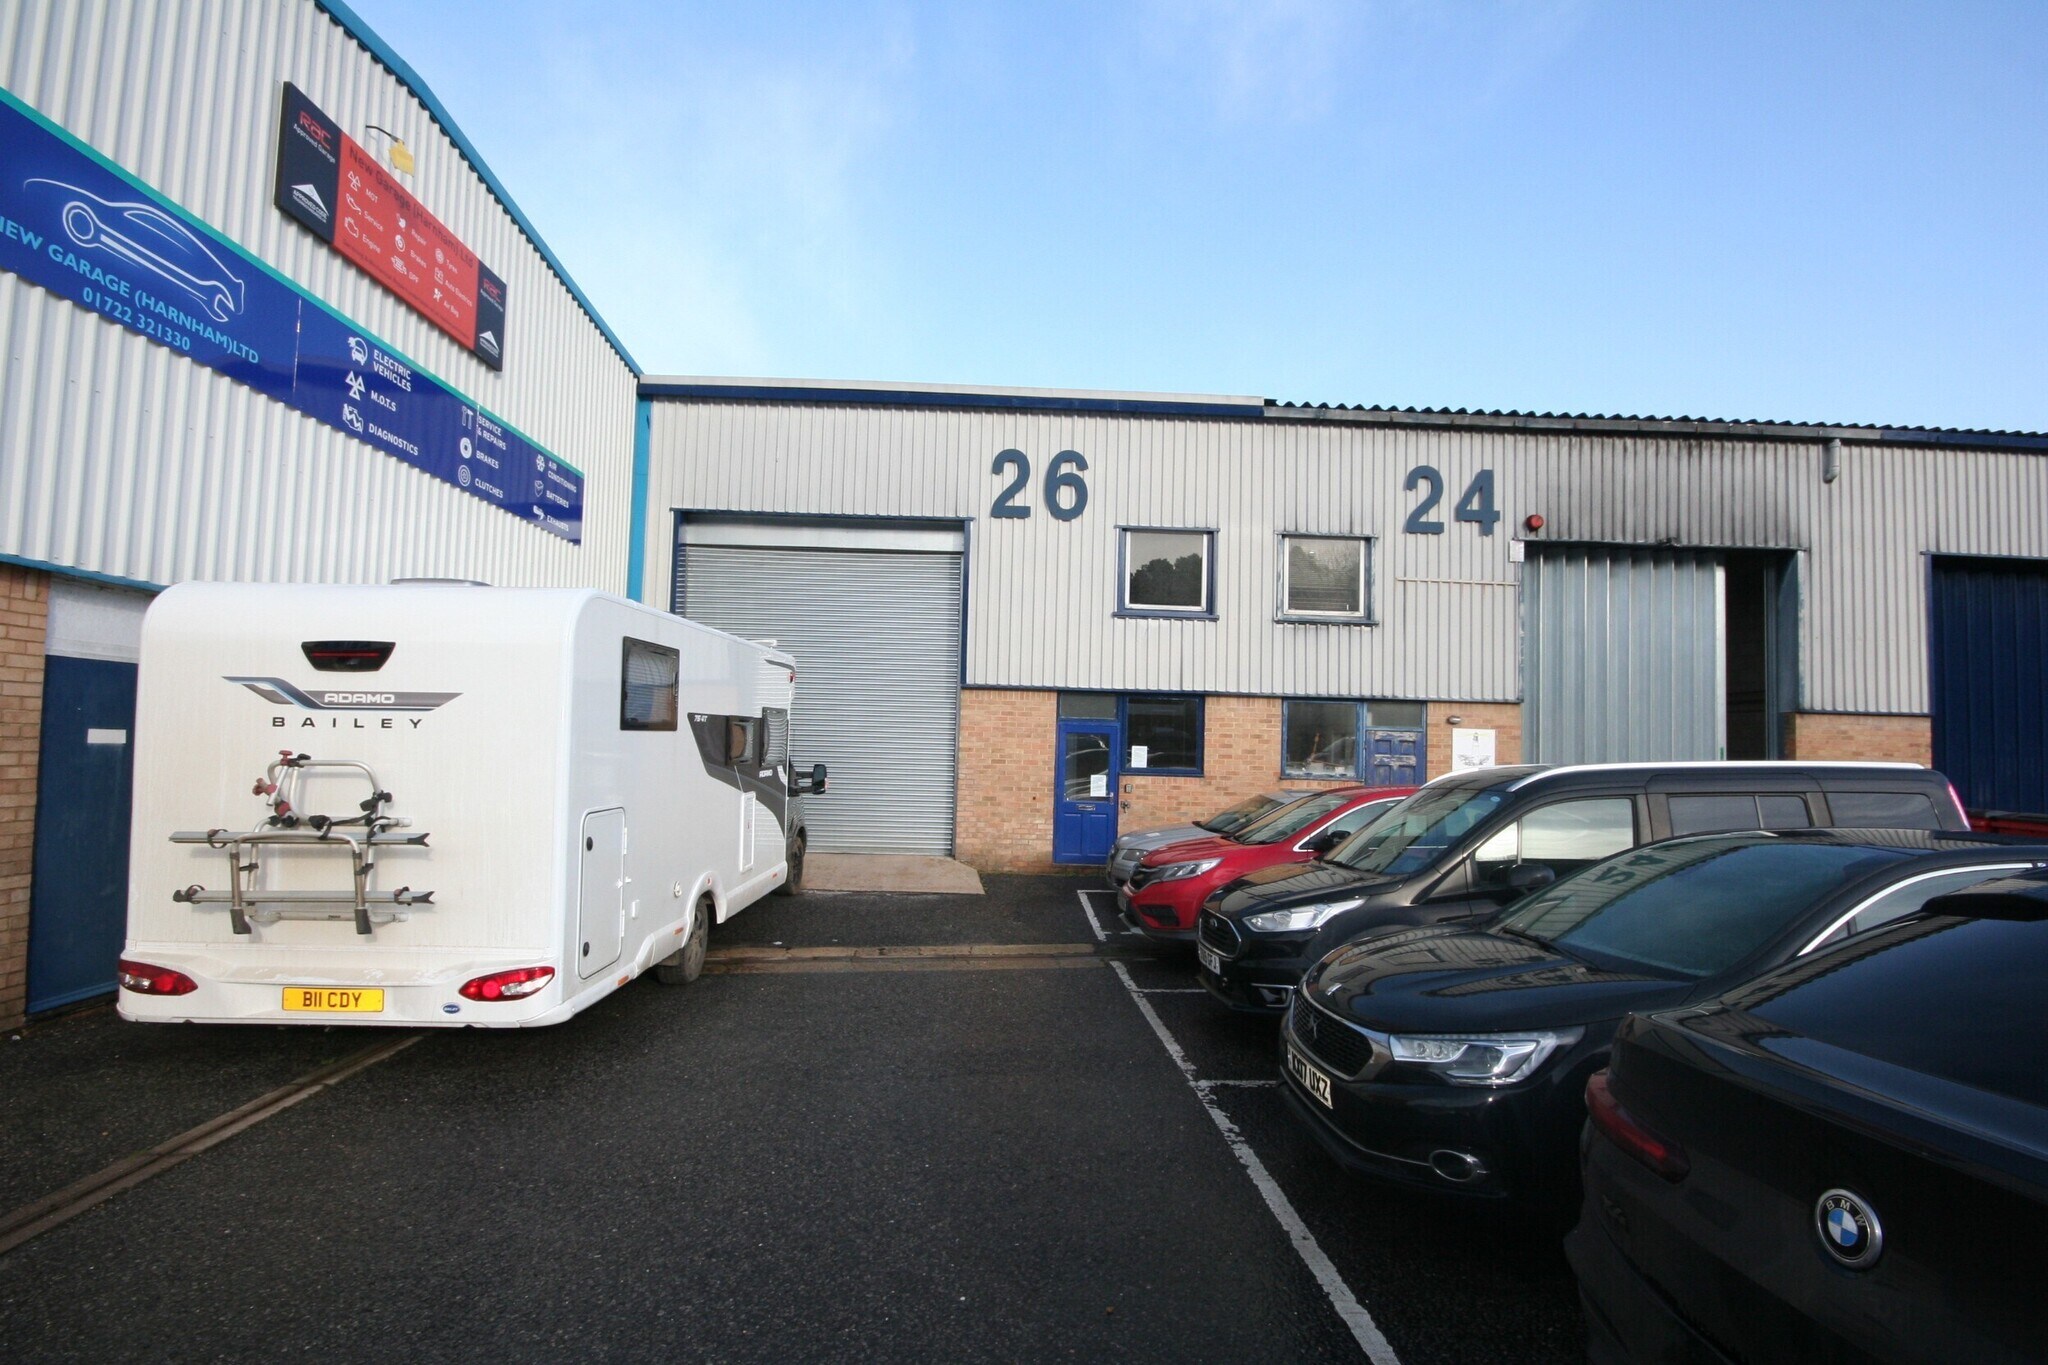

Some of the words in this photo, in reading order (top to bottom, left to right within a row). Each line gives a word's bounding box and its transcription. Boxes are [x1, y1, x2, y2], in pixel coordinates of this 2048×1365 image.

[349, 146, 373, 176] New
[375, 170, 411, 212] Garage
[365, 188, 378, 203] MOT
[364, 210, 383, 232] Service
[362, 234, 381, 254] Engine
[48, 244, 130, 298] GARAGE
[83, 287, 132, 324] 01722
[137, 313, 191, 351] 321330
[373, 349, 411, 380] ELECTRIC
[373, 361, 412, 392] VEHICLES
[478, 415, 502, 437] SERVICE
[368, 423, 419, 456] DIAGNOSTICS
[482, 430, 507, 451] REPAIRS
[476, 450, 499, 469] BRAKES
[548, 461, 557, 471] AIR
[474, 478, 504, 499] CLUTCHES
[547, 470, 577, 493] CONDITIONING
[990, 448, 1089, 522] 26
[546, 490, 569, 509] BATTERIES
[1405, 465, 1500, 537] 24
[547, 515, 569, 532] EXHAUSTS
[324, 693, 395, 704] ADAMO
[271, 716, 423, 729] BAILEY
[327, 992, 362, 1008] CDY
[1309, 1068, 1329, 1102] UXZ
[1826, 1199, 1866, 1226] BMW
